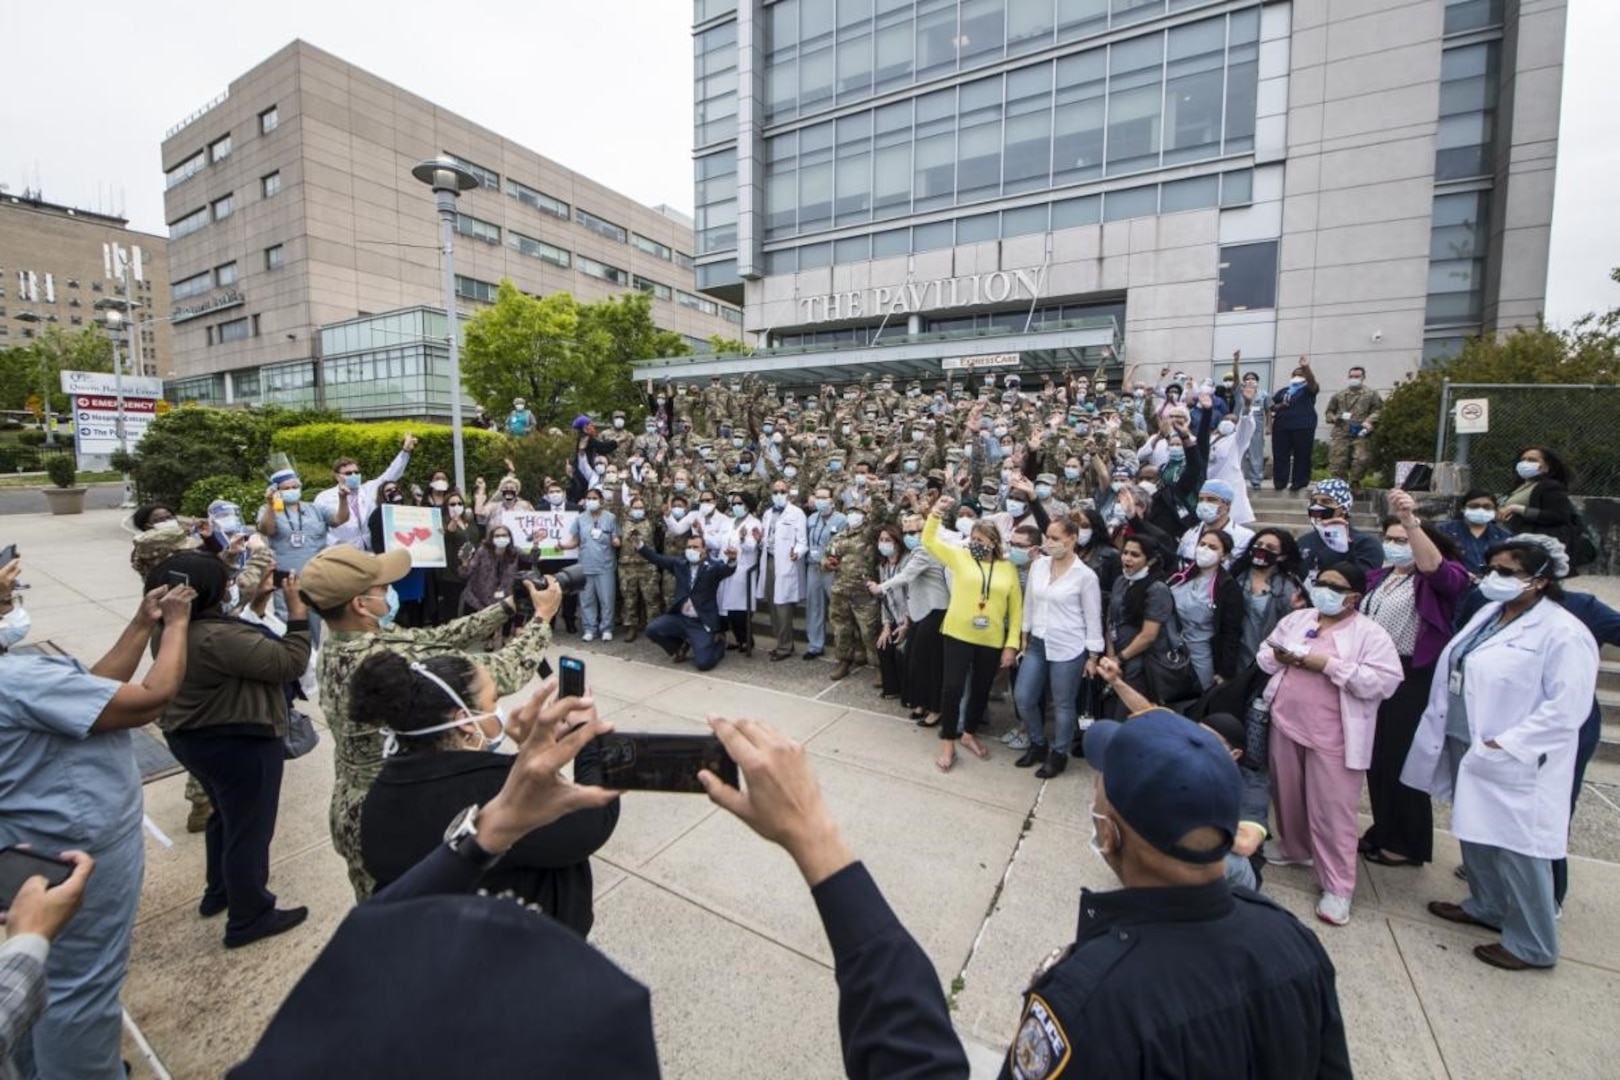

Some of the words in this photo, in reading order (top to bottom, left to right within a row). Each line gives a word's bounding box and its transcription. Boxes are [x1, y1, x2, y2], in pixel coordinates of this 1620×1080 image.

[801, 290, 864, 323] THE
[874, 267, 1041, 317] PAVILION
[91, 399, 153, 410] EMEENCY
[1030, 1000, 1065, 1058] POLICE
